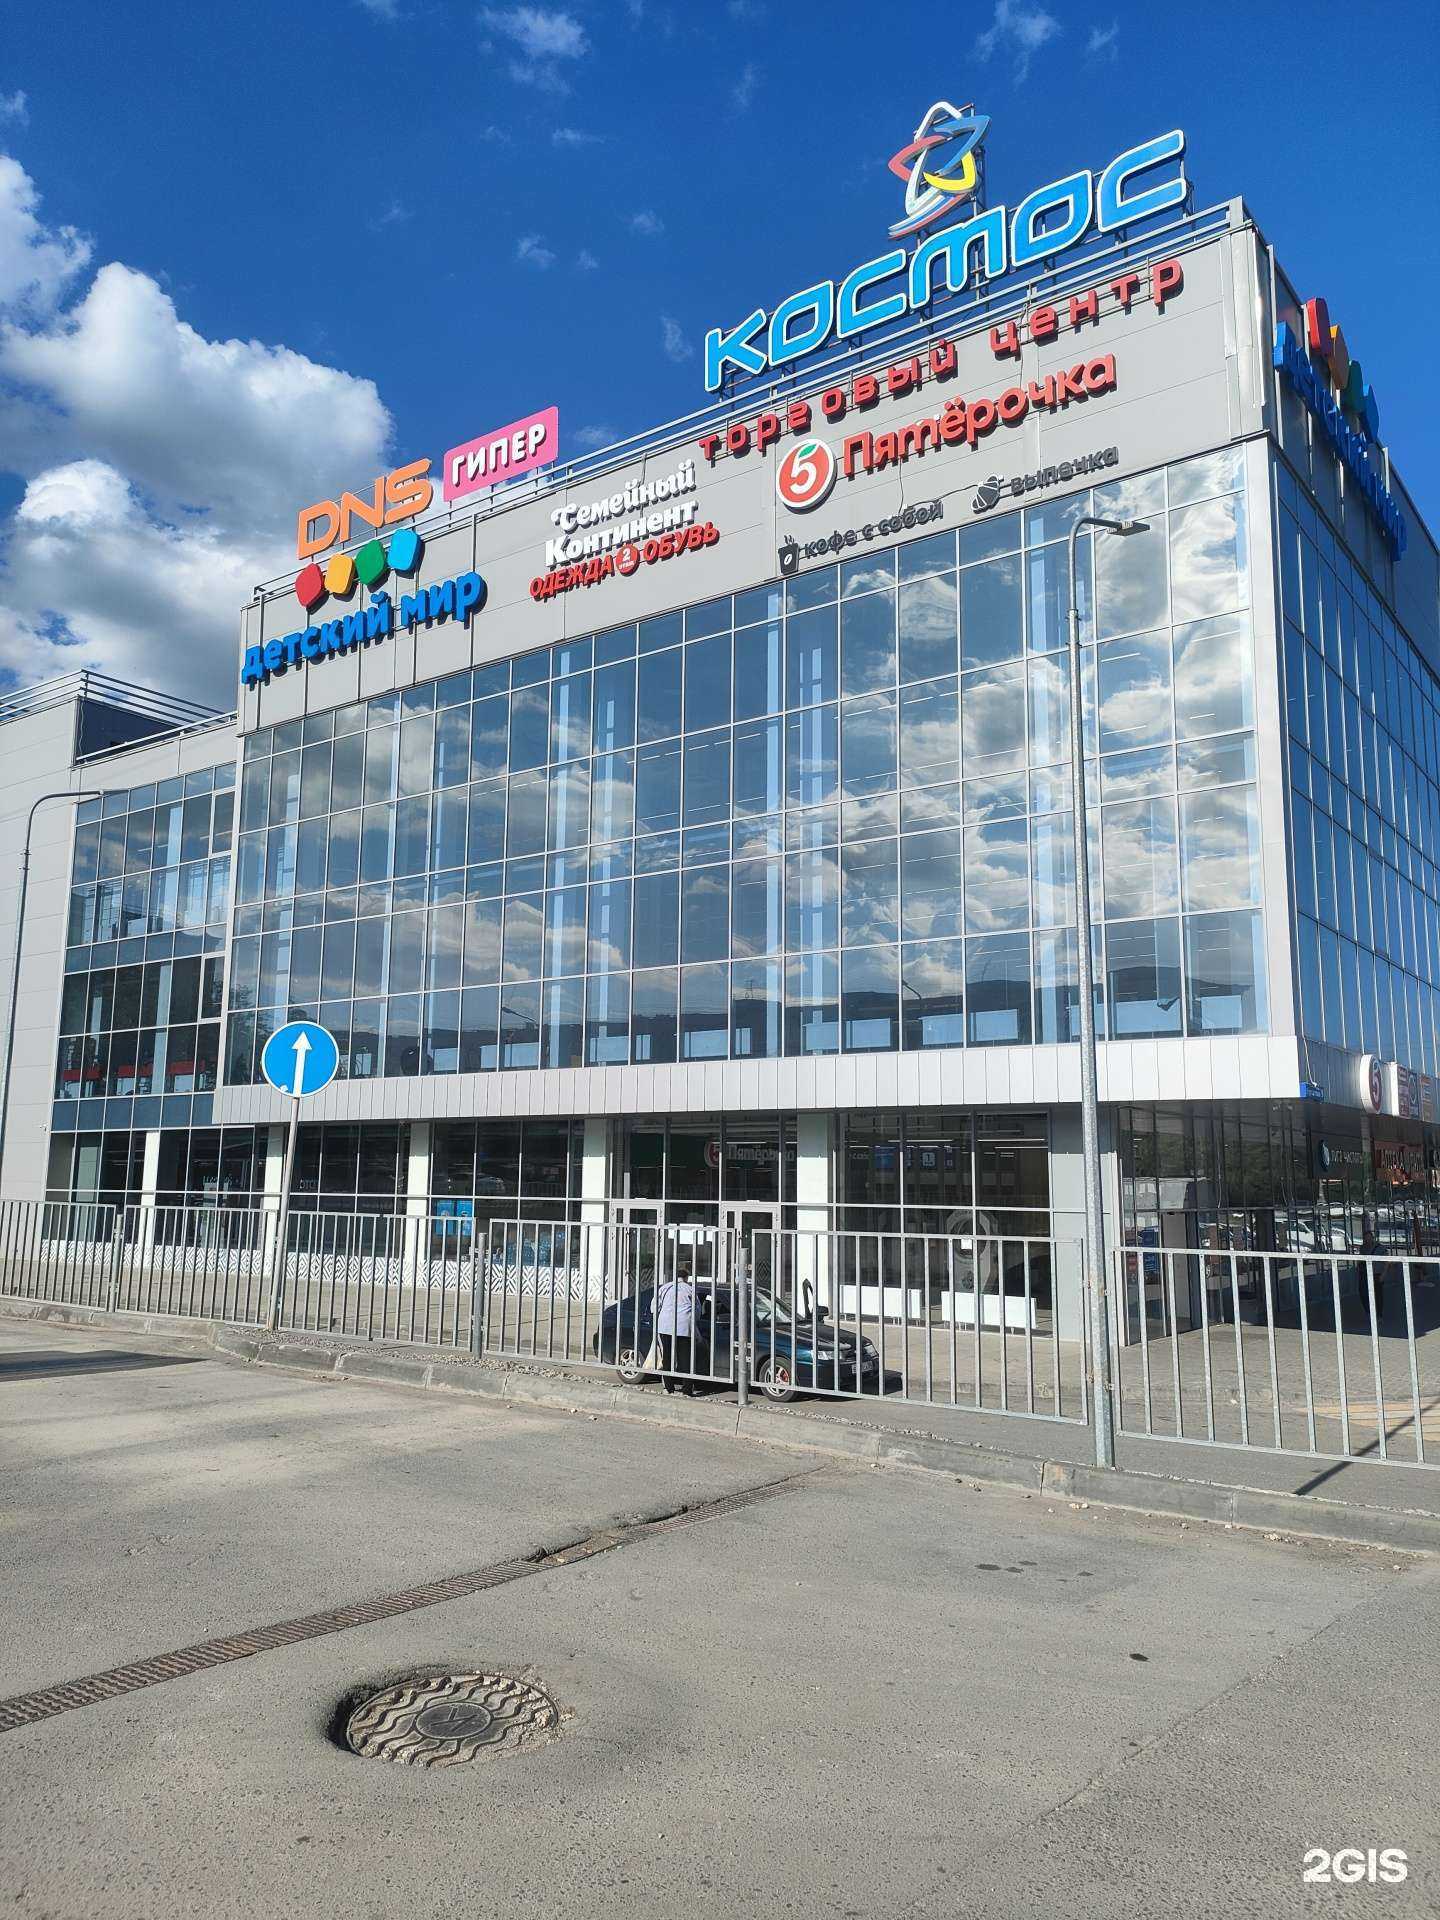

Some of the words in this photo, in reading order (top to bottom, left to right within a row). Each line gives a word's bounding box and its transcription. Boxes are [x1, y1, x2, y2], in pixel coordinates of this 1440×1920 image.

[699, 339, 956, 461] торговый
[990, 259, 1183, 354] центр
[843, 353, 1117, 477] Пятёрочка
[452, 422, 547, 487] ГИПЕР
[296, 457, 433, 560] DNS
[551, 458, 697, 533] Семейный
[804, 527, 857, 558] кофе
[878, 499, 945, 536] собой
[529, 554, 615, 601] ОДЕЖДА
[642, 521, 720, 563] ОБУВЬ
[545, 500, 699, 567] Континент
[622, 547, 632, 561] 2
[400, 571, 486, 624] мир
